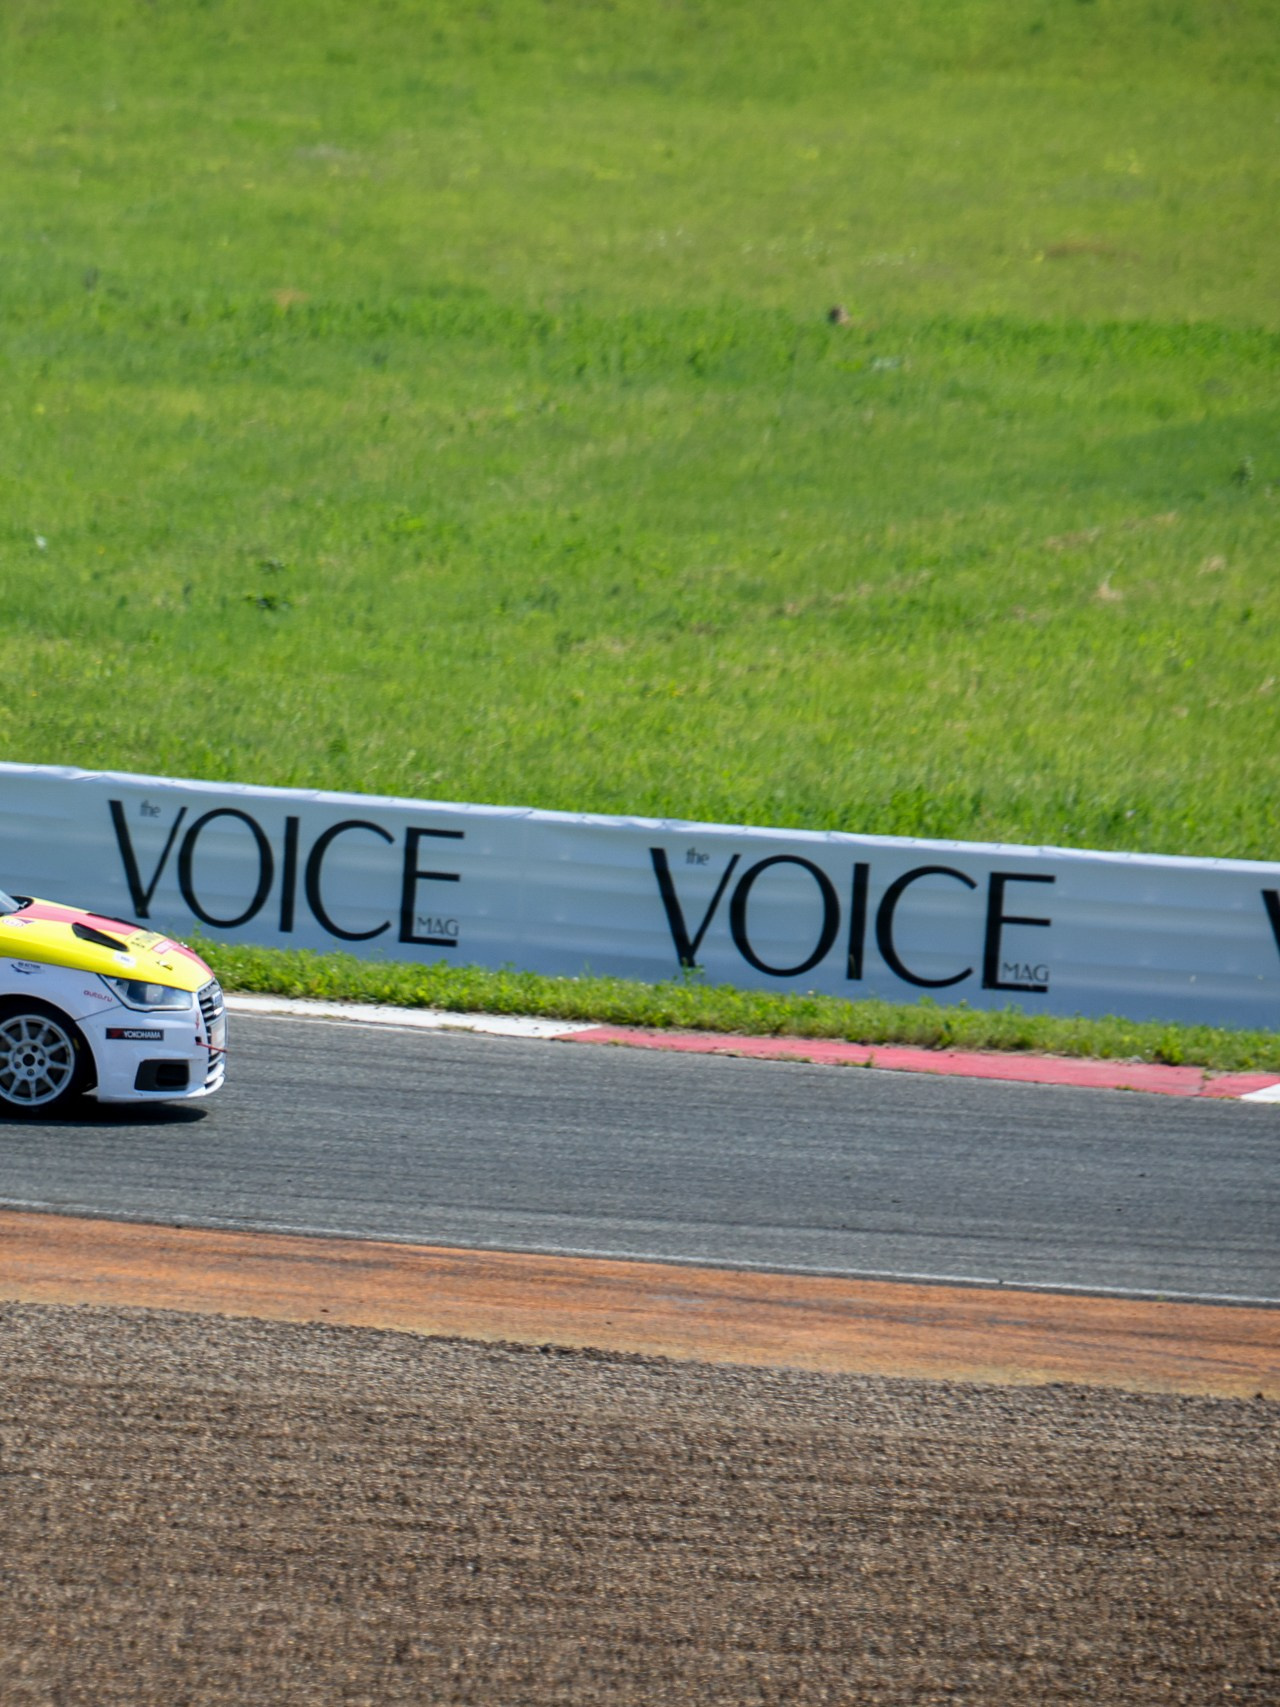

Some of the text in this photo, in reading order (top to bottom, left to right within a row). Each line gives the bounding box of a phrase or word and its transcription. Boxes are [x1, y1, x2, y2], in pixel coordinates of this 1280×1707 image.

[140, 801, 161, 818] the
[685, 847, 710, 866] the
[108, 799, 465, 947] VOICE
[417, 917, 460, 937] MAG
[649, 847, 1056, 994] VOICE
[1002, 961, 1050, 983] MAG
[123, 1030, 161, 1040] YOKOHAMA
